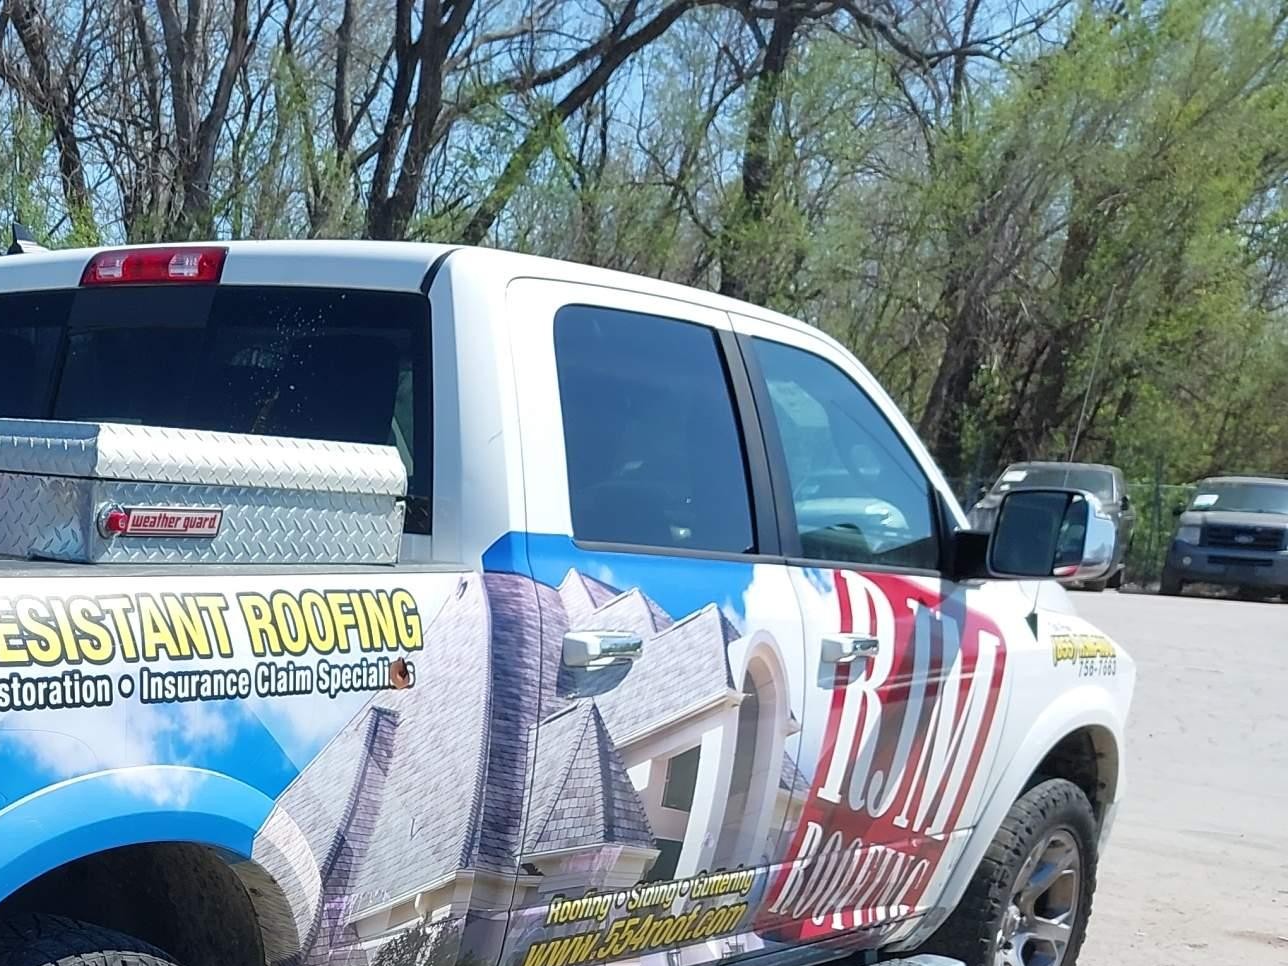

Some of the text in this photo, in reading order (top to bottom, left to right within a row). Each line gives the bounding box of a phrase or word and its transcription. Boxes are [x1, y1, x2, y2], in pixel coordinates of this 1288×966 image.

[131, 513, 216, 531] weather guard
[237, 588, 423, 657] ROOFING
[140, 667, 251, 704] Insurance
[256, 661, 313, 694] Claim
[317, 655, 416, 698] Specialis
[816, 569, 1003, 841] RJM
[547, 865, 757, 926] Roofing Siding Guttering
[768, 821, 930, 931] ROOFING
